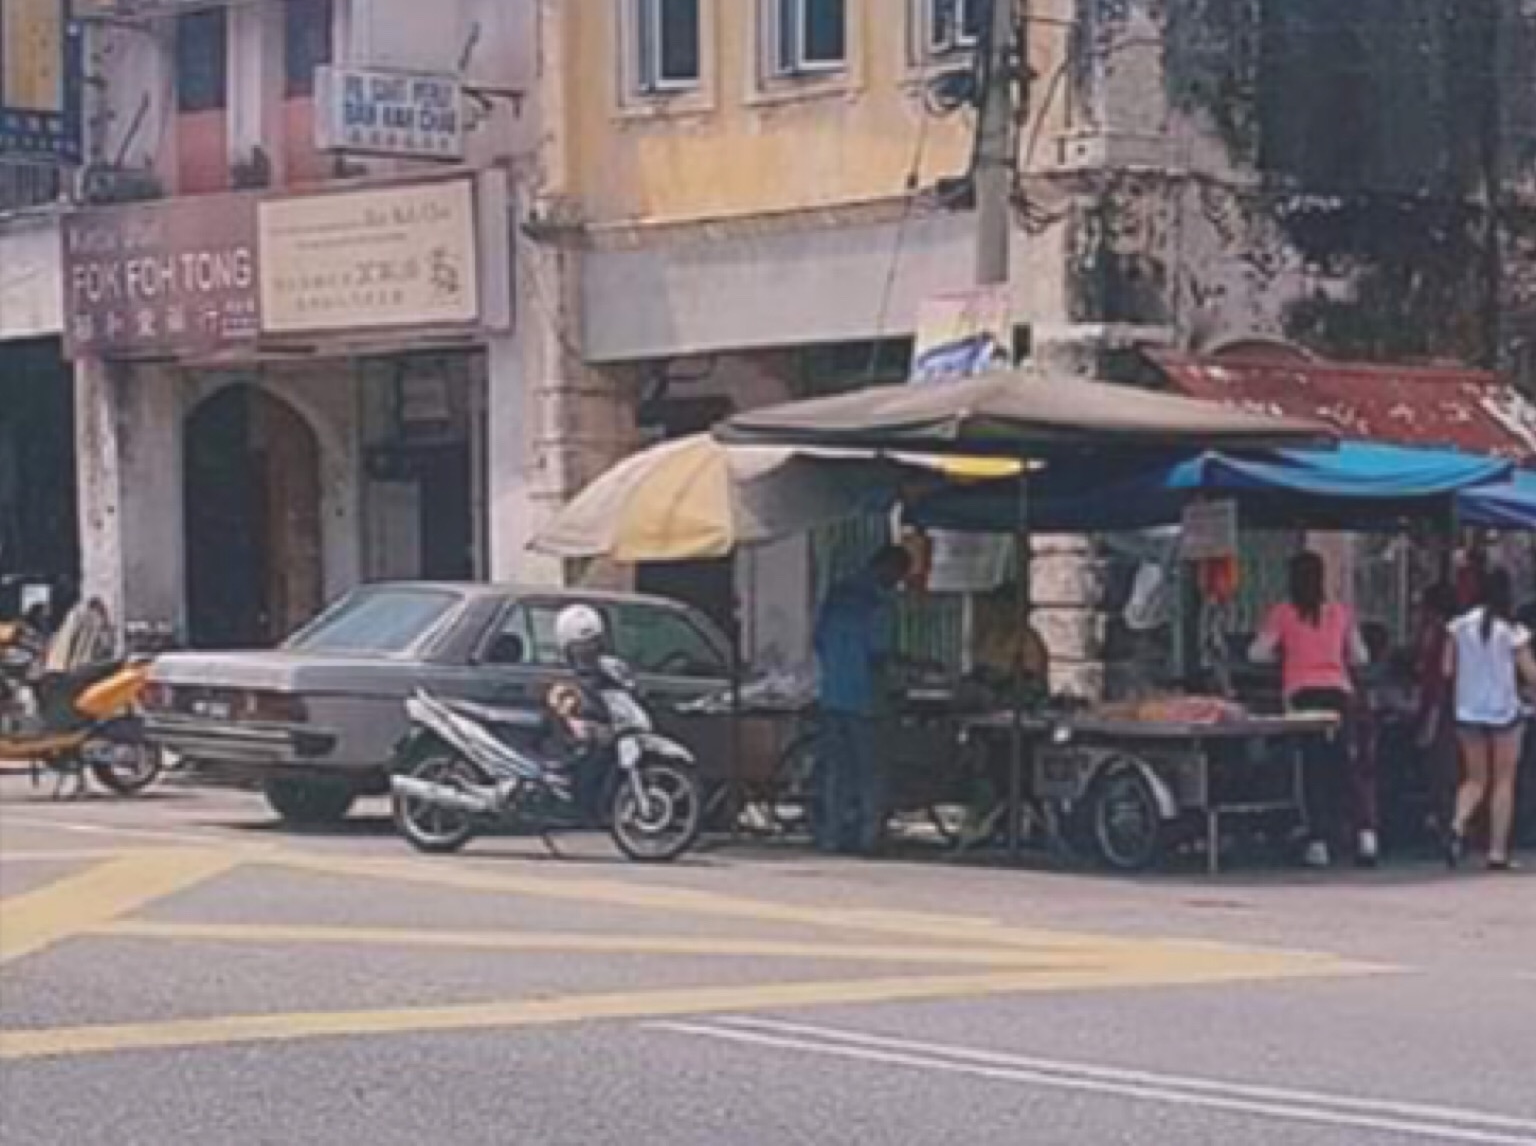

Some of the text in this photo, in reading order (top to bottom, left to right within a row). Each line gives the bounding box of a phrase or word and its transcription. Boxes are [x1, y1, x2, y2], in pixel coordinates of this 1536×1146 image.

[73, 262, 123, 303] FOK
[127, 254, 176, 300] FOH
[180, 246, 252, 292] TONG
